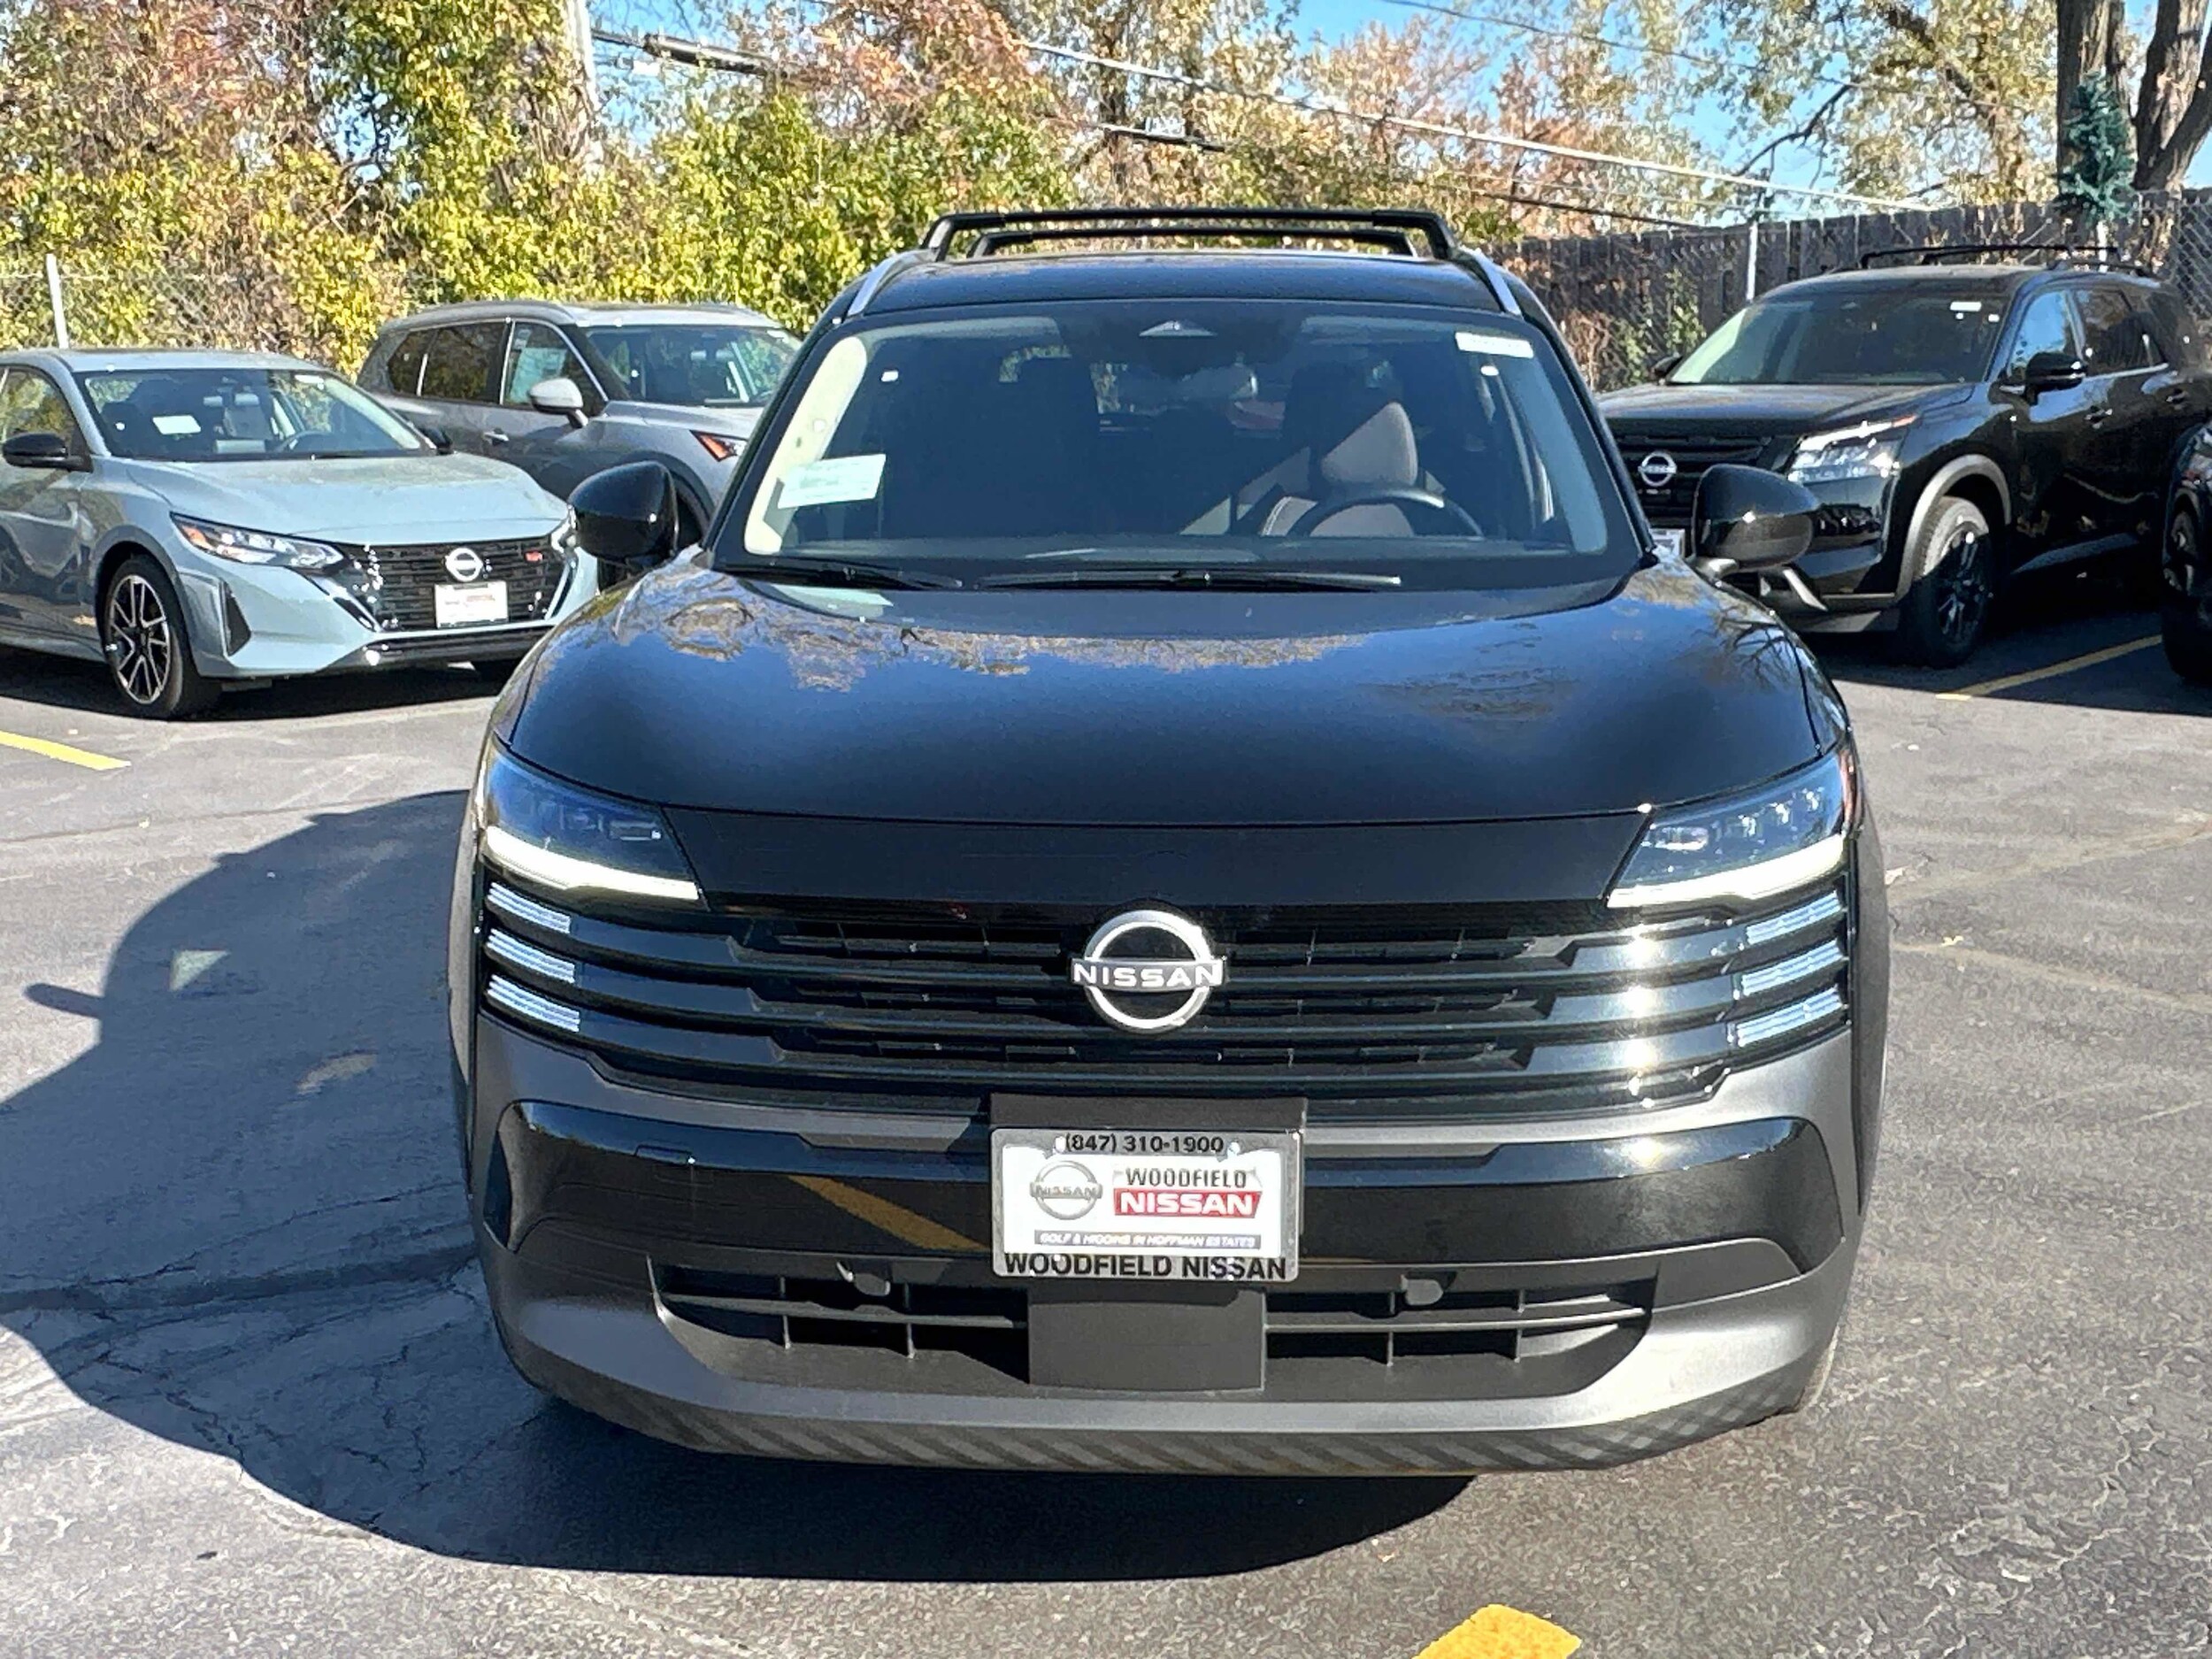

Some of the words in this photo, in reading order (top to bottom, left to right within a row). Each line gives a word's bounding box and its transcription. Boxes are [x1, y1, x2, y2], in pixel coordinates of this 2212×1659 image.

[1073, 963, 1223, 987] NISSAN
[1065, 1133, 1117, 1153] (847)
[1123, 1135, 1225, 1153] 310-1900
[1125, 1166, 1248, 1188] WOODFIELD
[1035, 1185, 1097, 1197] NISSAN
[1119, 1192, 1254, 1216] NISSAN
[1004, 1253, 1172, 1277] WOODFIELD
[1181, 1257, 1286, 1280] NISSAN
